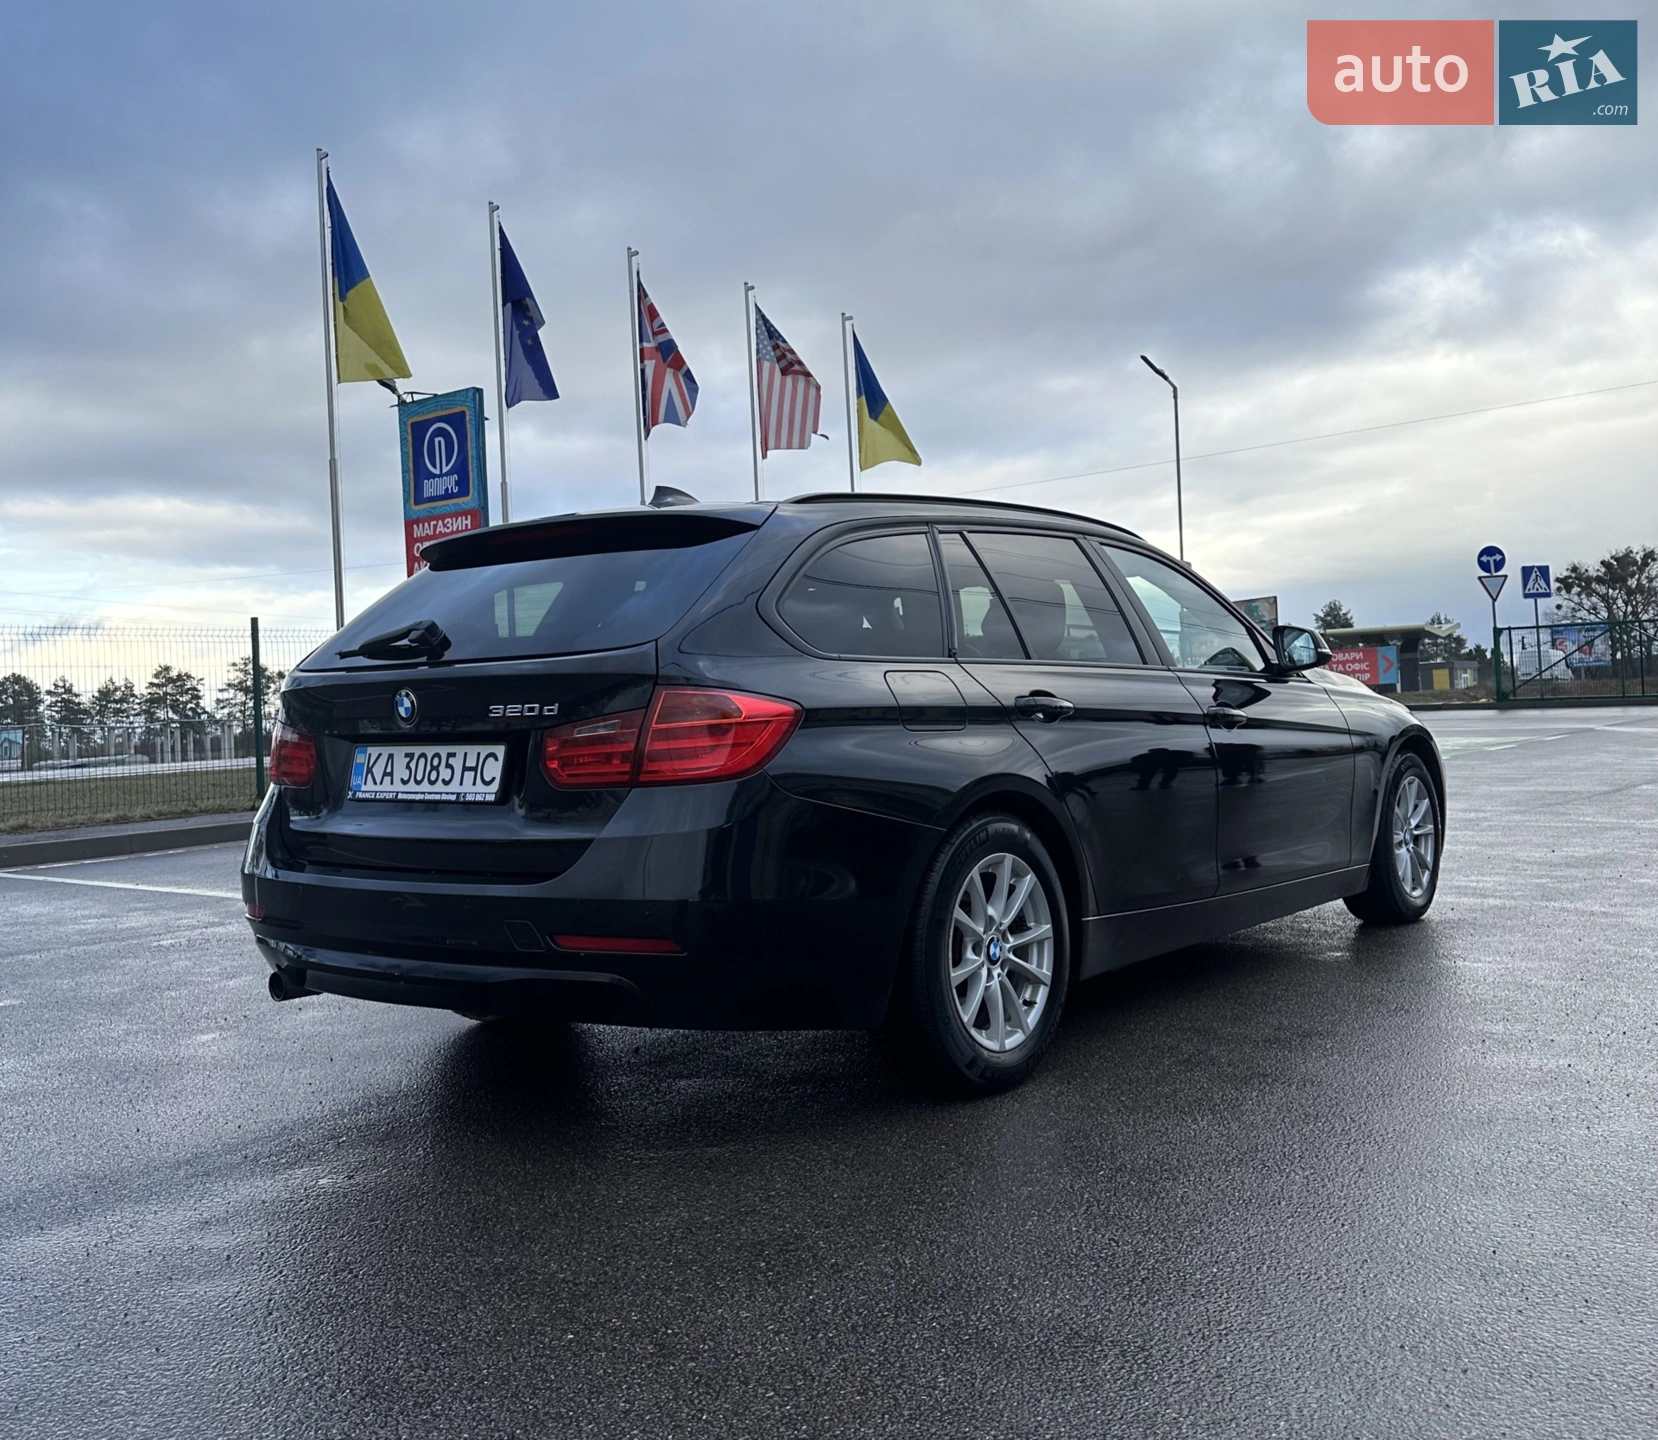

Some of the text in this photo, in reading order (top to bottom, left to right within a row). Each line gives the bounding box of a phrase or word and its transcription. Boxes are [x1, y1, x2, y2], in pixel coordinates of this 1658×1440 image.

[423, 474, 459, 498] ПАПІРУС
[413, 515, 471, 538] МАГАЗИН
[1332, 652, 1363, 662] ОВАРИ
[1346, 662, 1370, 671] ОФІС
[364, 751, 498, 786] KA 3085 HC
[352, 774, 362, 785] UA
[355, 791, 376, 799] FRANCE
[376, 791, 397, 799] EXPERT
